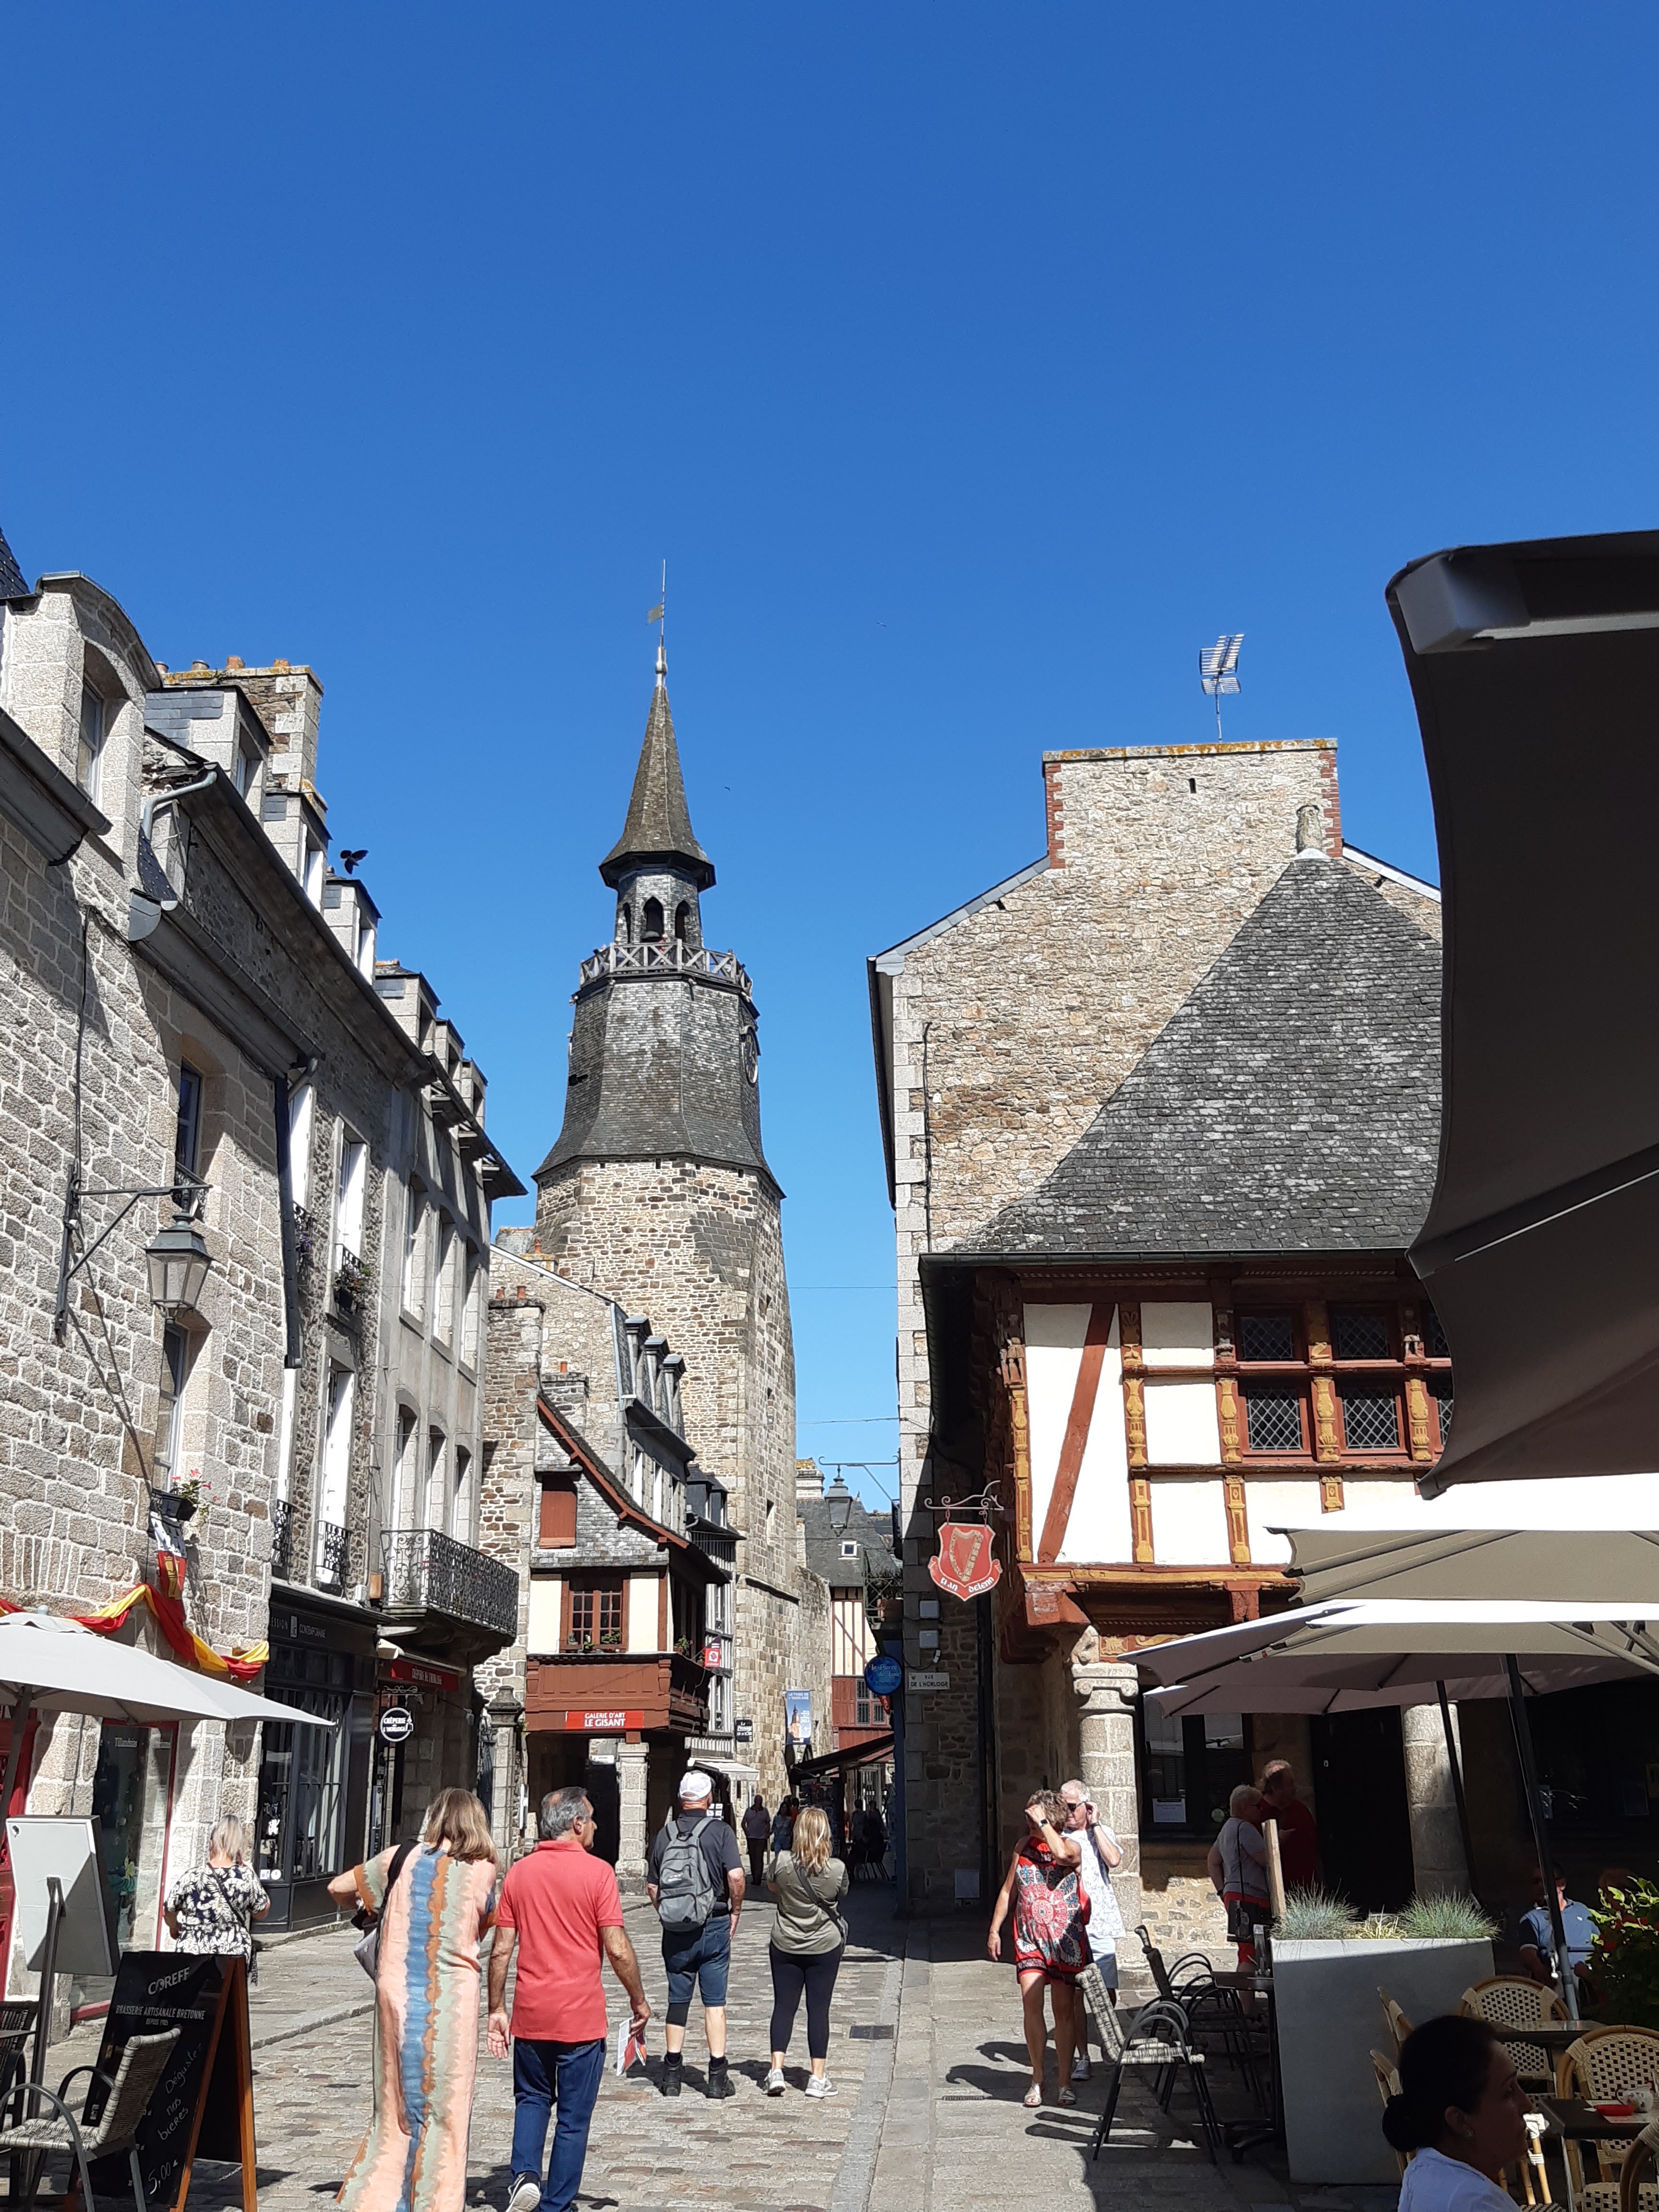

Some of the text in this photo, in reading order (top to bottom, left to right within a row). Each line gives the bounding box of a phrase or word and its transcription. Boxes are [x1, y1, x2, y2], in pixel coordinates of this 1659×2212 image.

[584, 1718, 626, 1727] LE GISANT
[148, 1967, 191, 1995] COREFF
[115, 2005, 206, 2020] BRASSERIE ARTISANALE BRETONNE
[166, 2097, 182, 2116] nos
